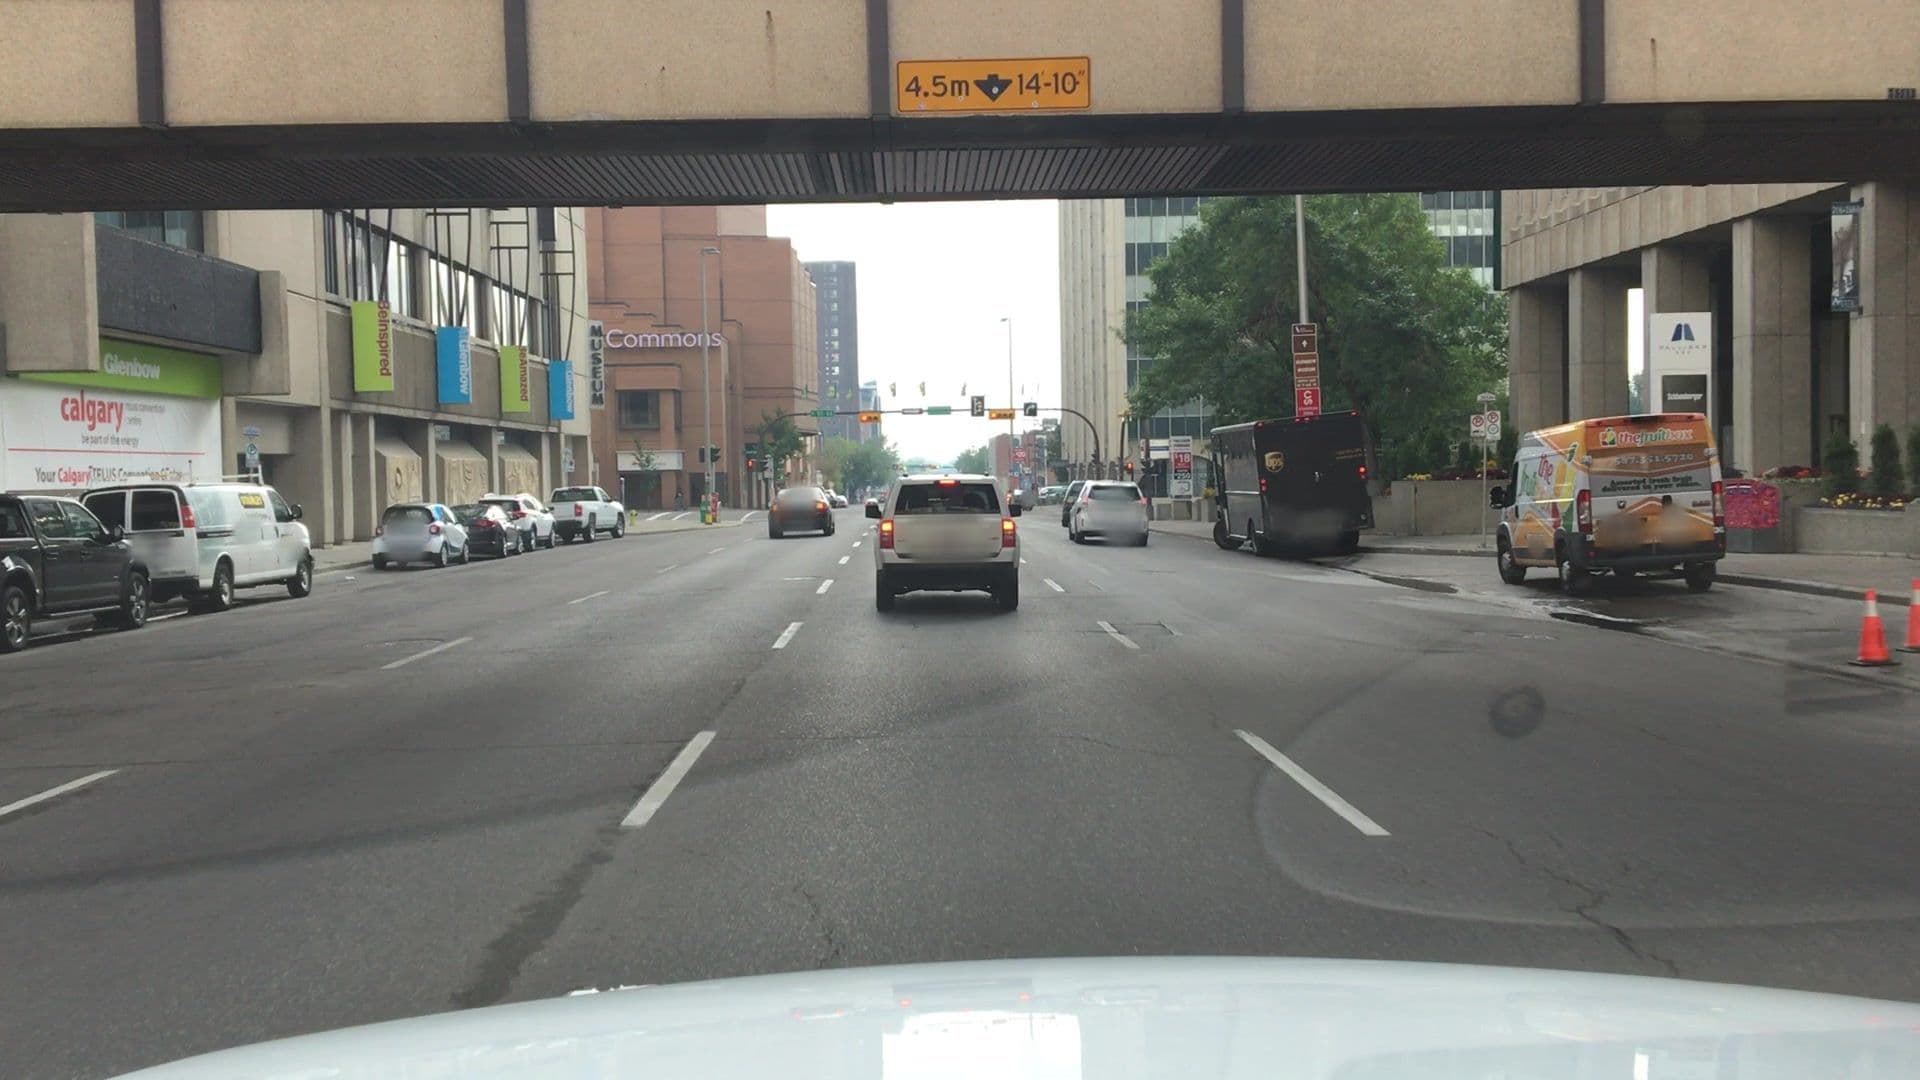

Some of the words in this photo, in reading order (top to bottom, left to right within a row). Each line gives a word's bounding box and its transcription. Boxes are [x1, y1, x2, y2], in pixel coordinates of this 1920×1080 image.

[904, 73, 970, 98] 4.5m
[376, 299, 392, 377] BeInspired
[605, 328, 722, 349] Commons
[104, 352, 161, 380] Glenbow
[590, 325, 604, 406] MUSEUM
[60, 389, 124, 432] calgary
[110, 435, 120, 445] the
[34, 466, 56, 483] Your
[57, 466, 90, 486] Calgary
